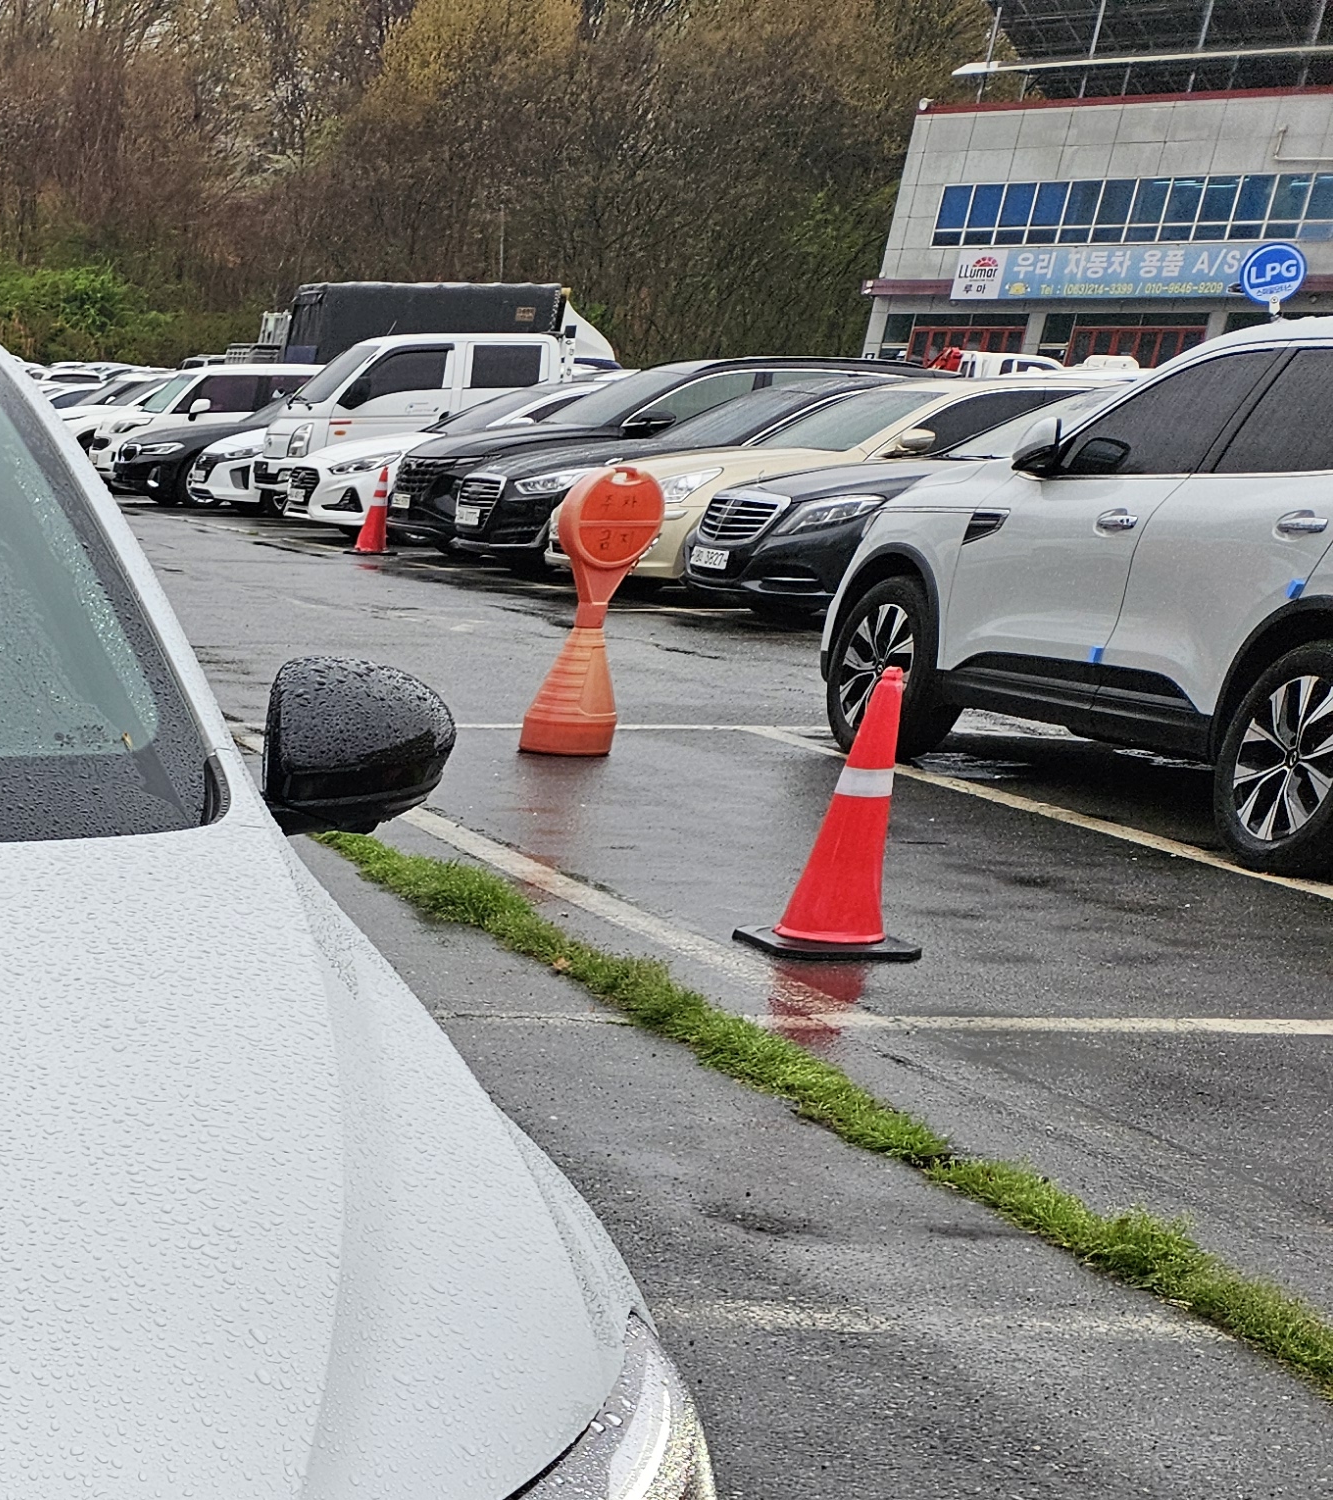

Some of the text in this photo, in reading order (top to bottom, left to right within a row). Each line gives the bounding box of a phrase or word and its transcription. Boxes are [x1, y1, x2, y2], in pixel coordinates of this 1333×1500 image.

[958, 264, 998, 279] LLumar
[1013, 249, 1249, 279] 우리 자동차 용품 A/S
[1250, 260, 1298, 284] LPG
[601, 494, 638, 512] 주차
[599, 529, 635, 550] 금지
